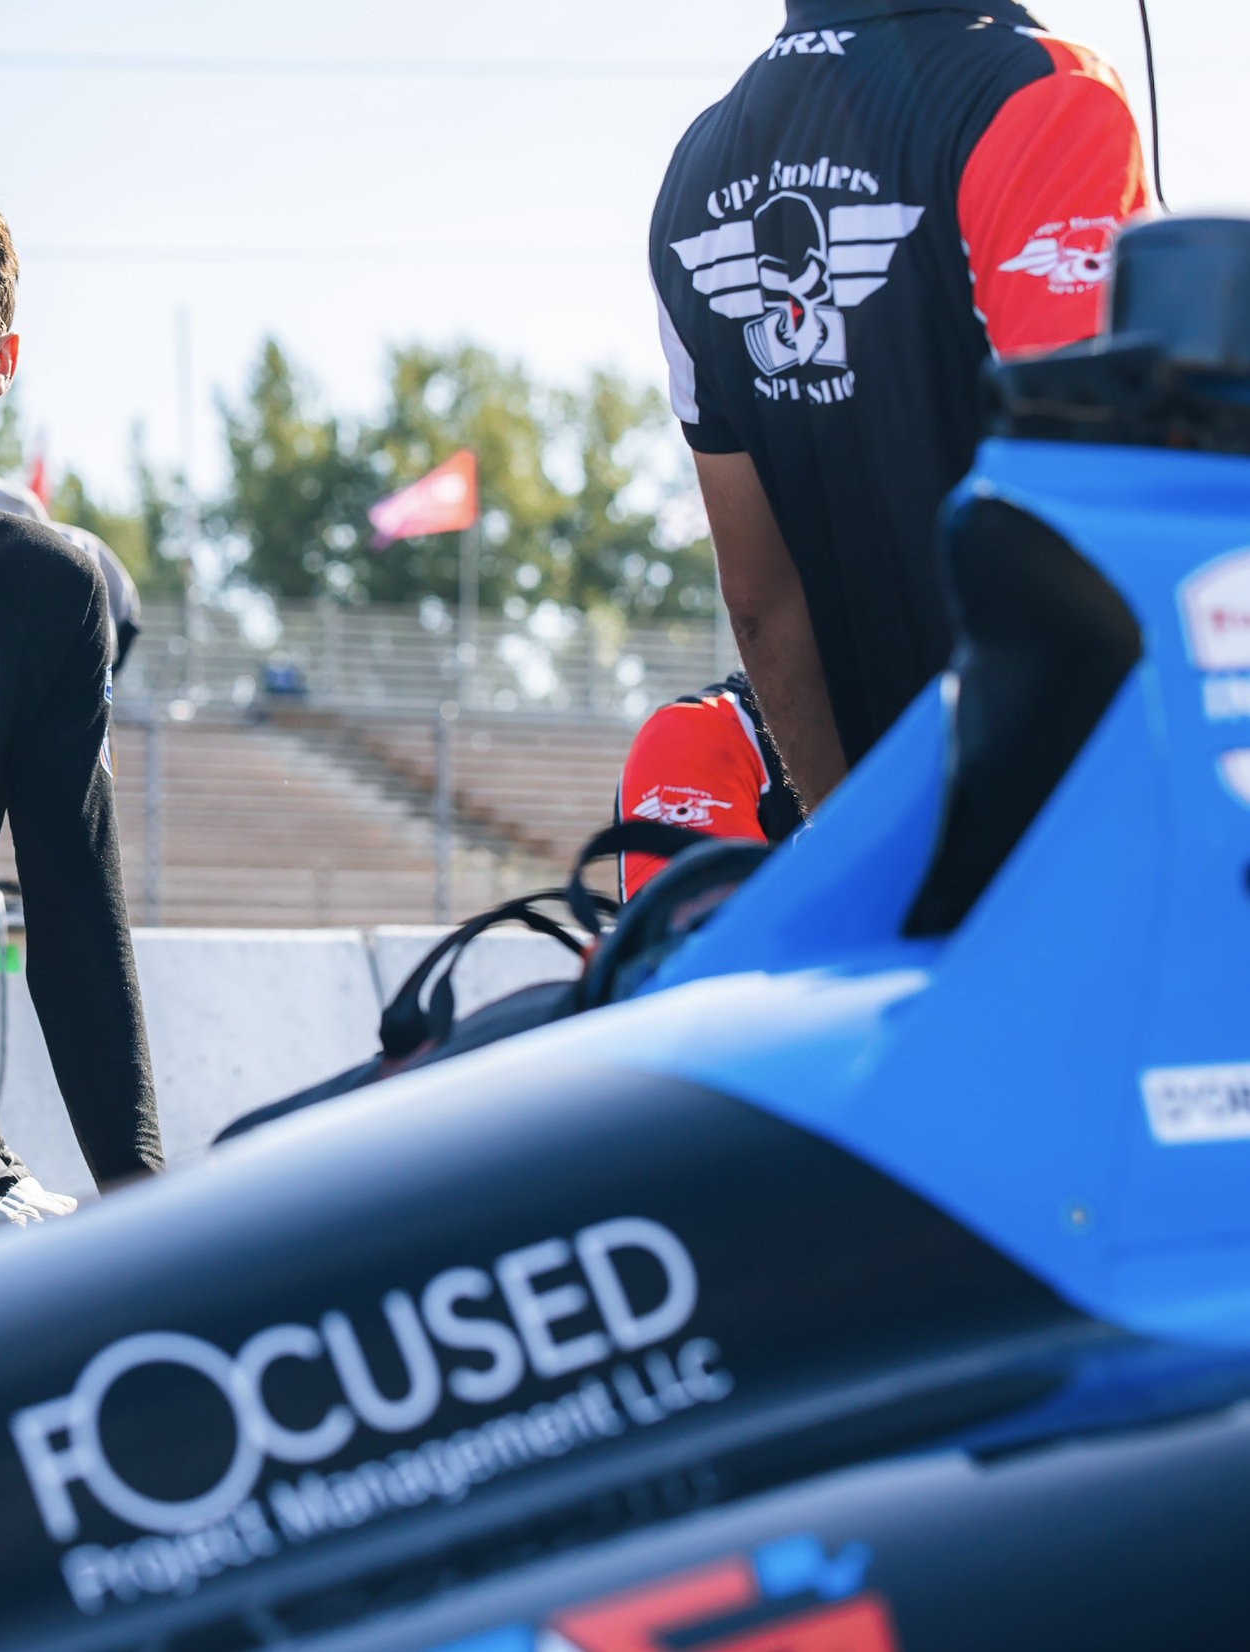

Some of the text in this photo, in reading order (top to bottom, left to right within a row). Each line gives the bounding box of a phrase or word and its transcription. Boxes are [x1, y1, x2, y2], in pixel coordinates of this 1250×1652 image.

[767, 29, 857, 61] HRX
[9, 1216, 700, 1545] FOCUSED
[60, 1336, 735, 1616] Project Management LLC
